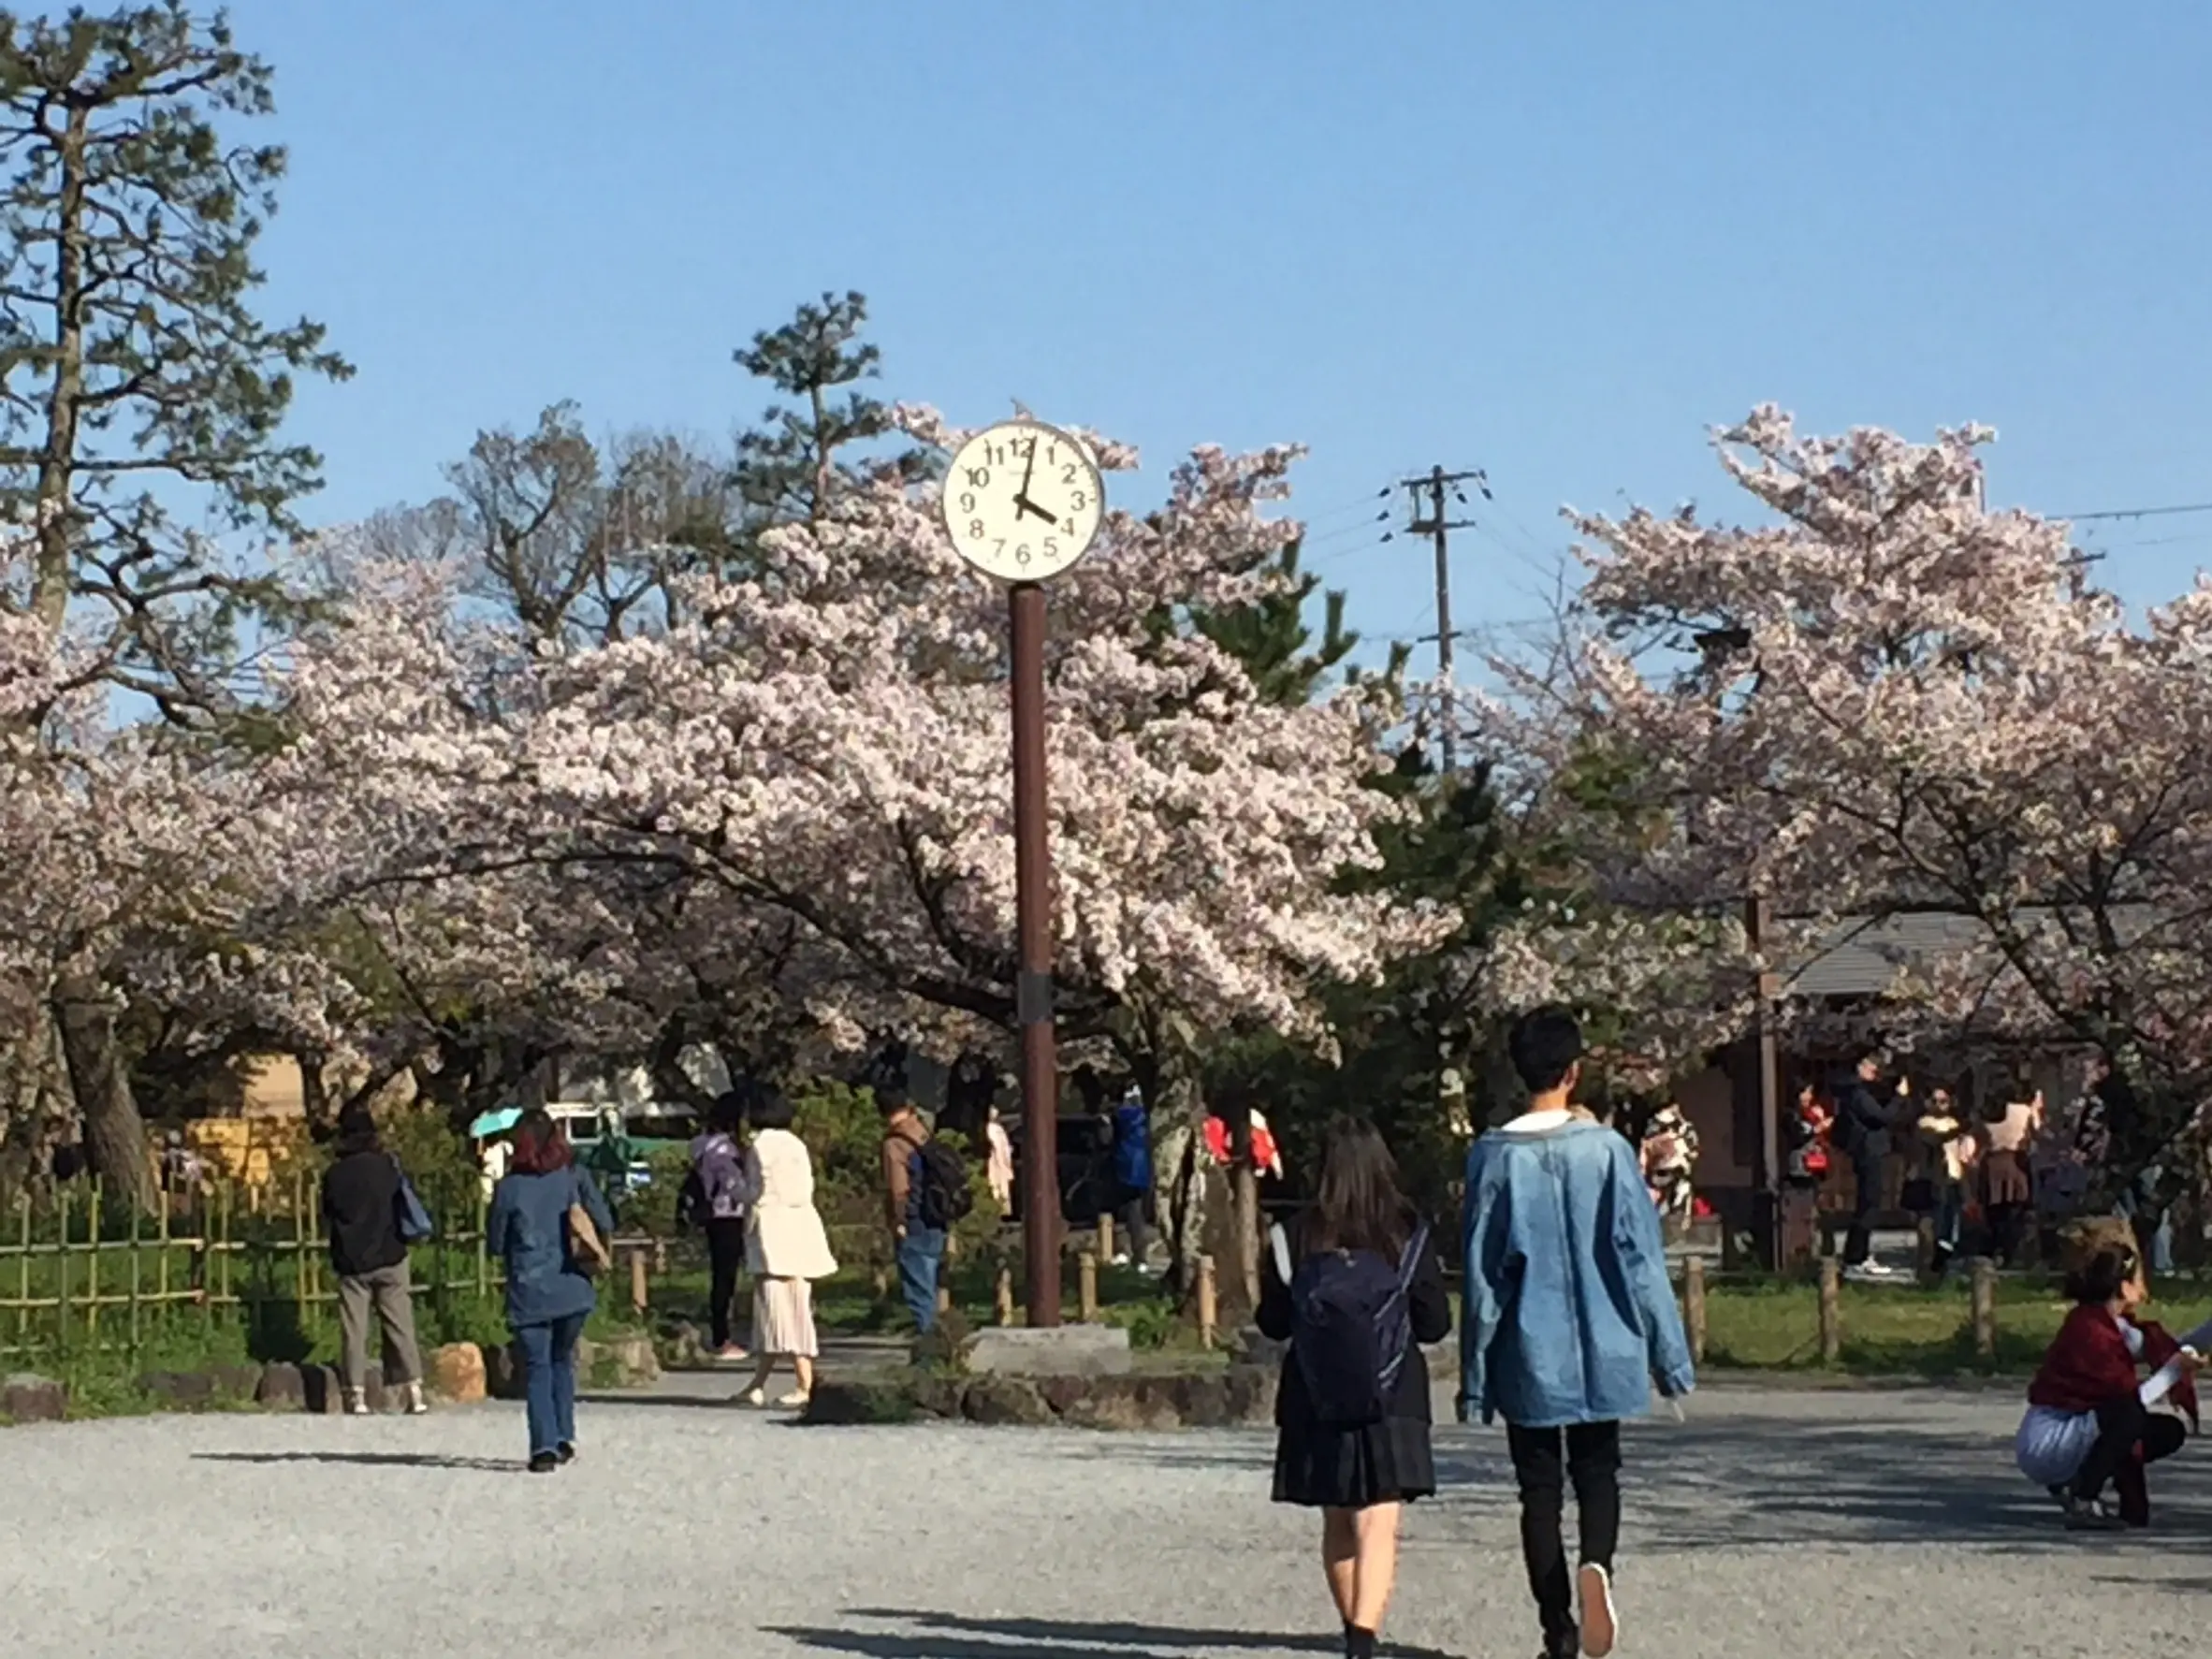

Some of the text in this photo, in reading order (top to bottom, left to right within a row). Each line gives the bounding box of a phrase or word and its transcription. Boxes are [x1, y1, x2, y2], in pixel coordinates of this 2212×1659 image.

[984, 445, 1004, 465] 11
[1009, 438, 1034, 458] 12
[1046, 445, 1055, 465] 1
[967, 467, 989, 488] 10
[1061, 462, 1076, 484] 2
[960, 492, 975, 513] 9
[1070, 490, 1085, 511] 3
[969, 518, 984, 539] 8
[1060, 517, 1074, 537] 4
[992, 538, 1006, 558] 7
[1015, 544, 1031, 564] 6
[1043, 536, 1057, 557] 5
